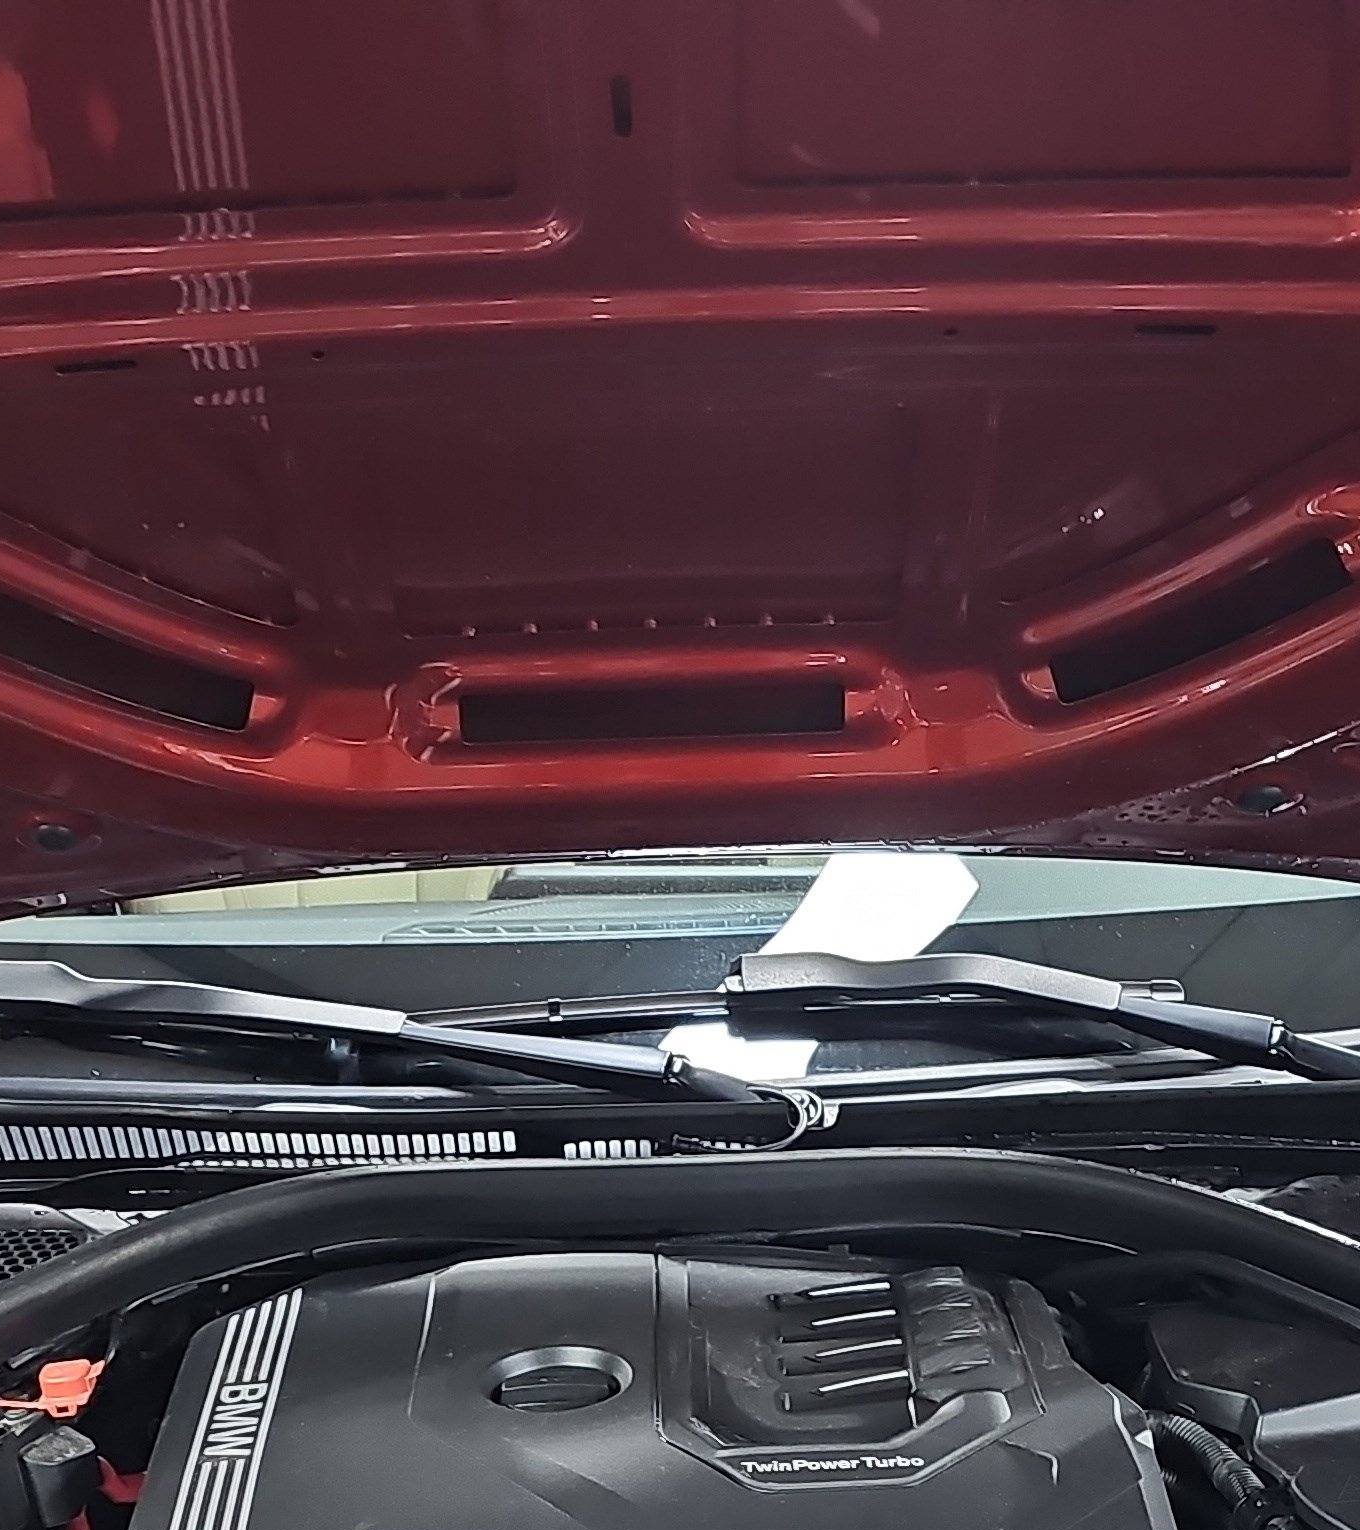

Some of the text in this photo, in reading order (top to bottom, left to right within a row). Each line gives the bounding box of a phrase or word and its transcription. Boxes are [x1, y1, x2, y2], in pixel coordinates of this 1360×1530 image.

[202, 1382, 269, 1456] BMW
[740, 1455, 925, 1473] TwinPower Turbo
